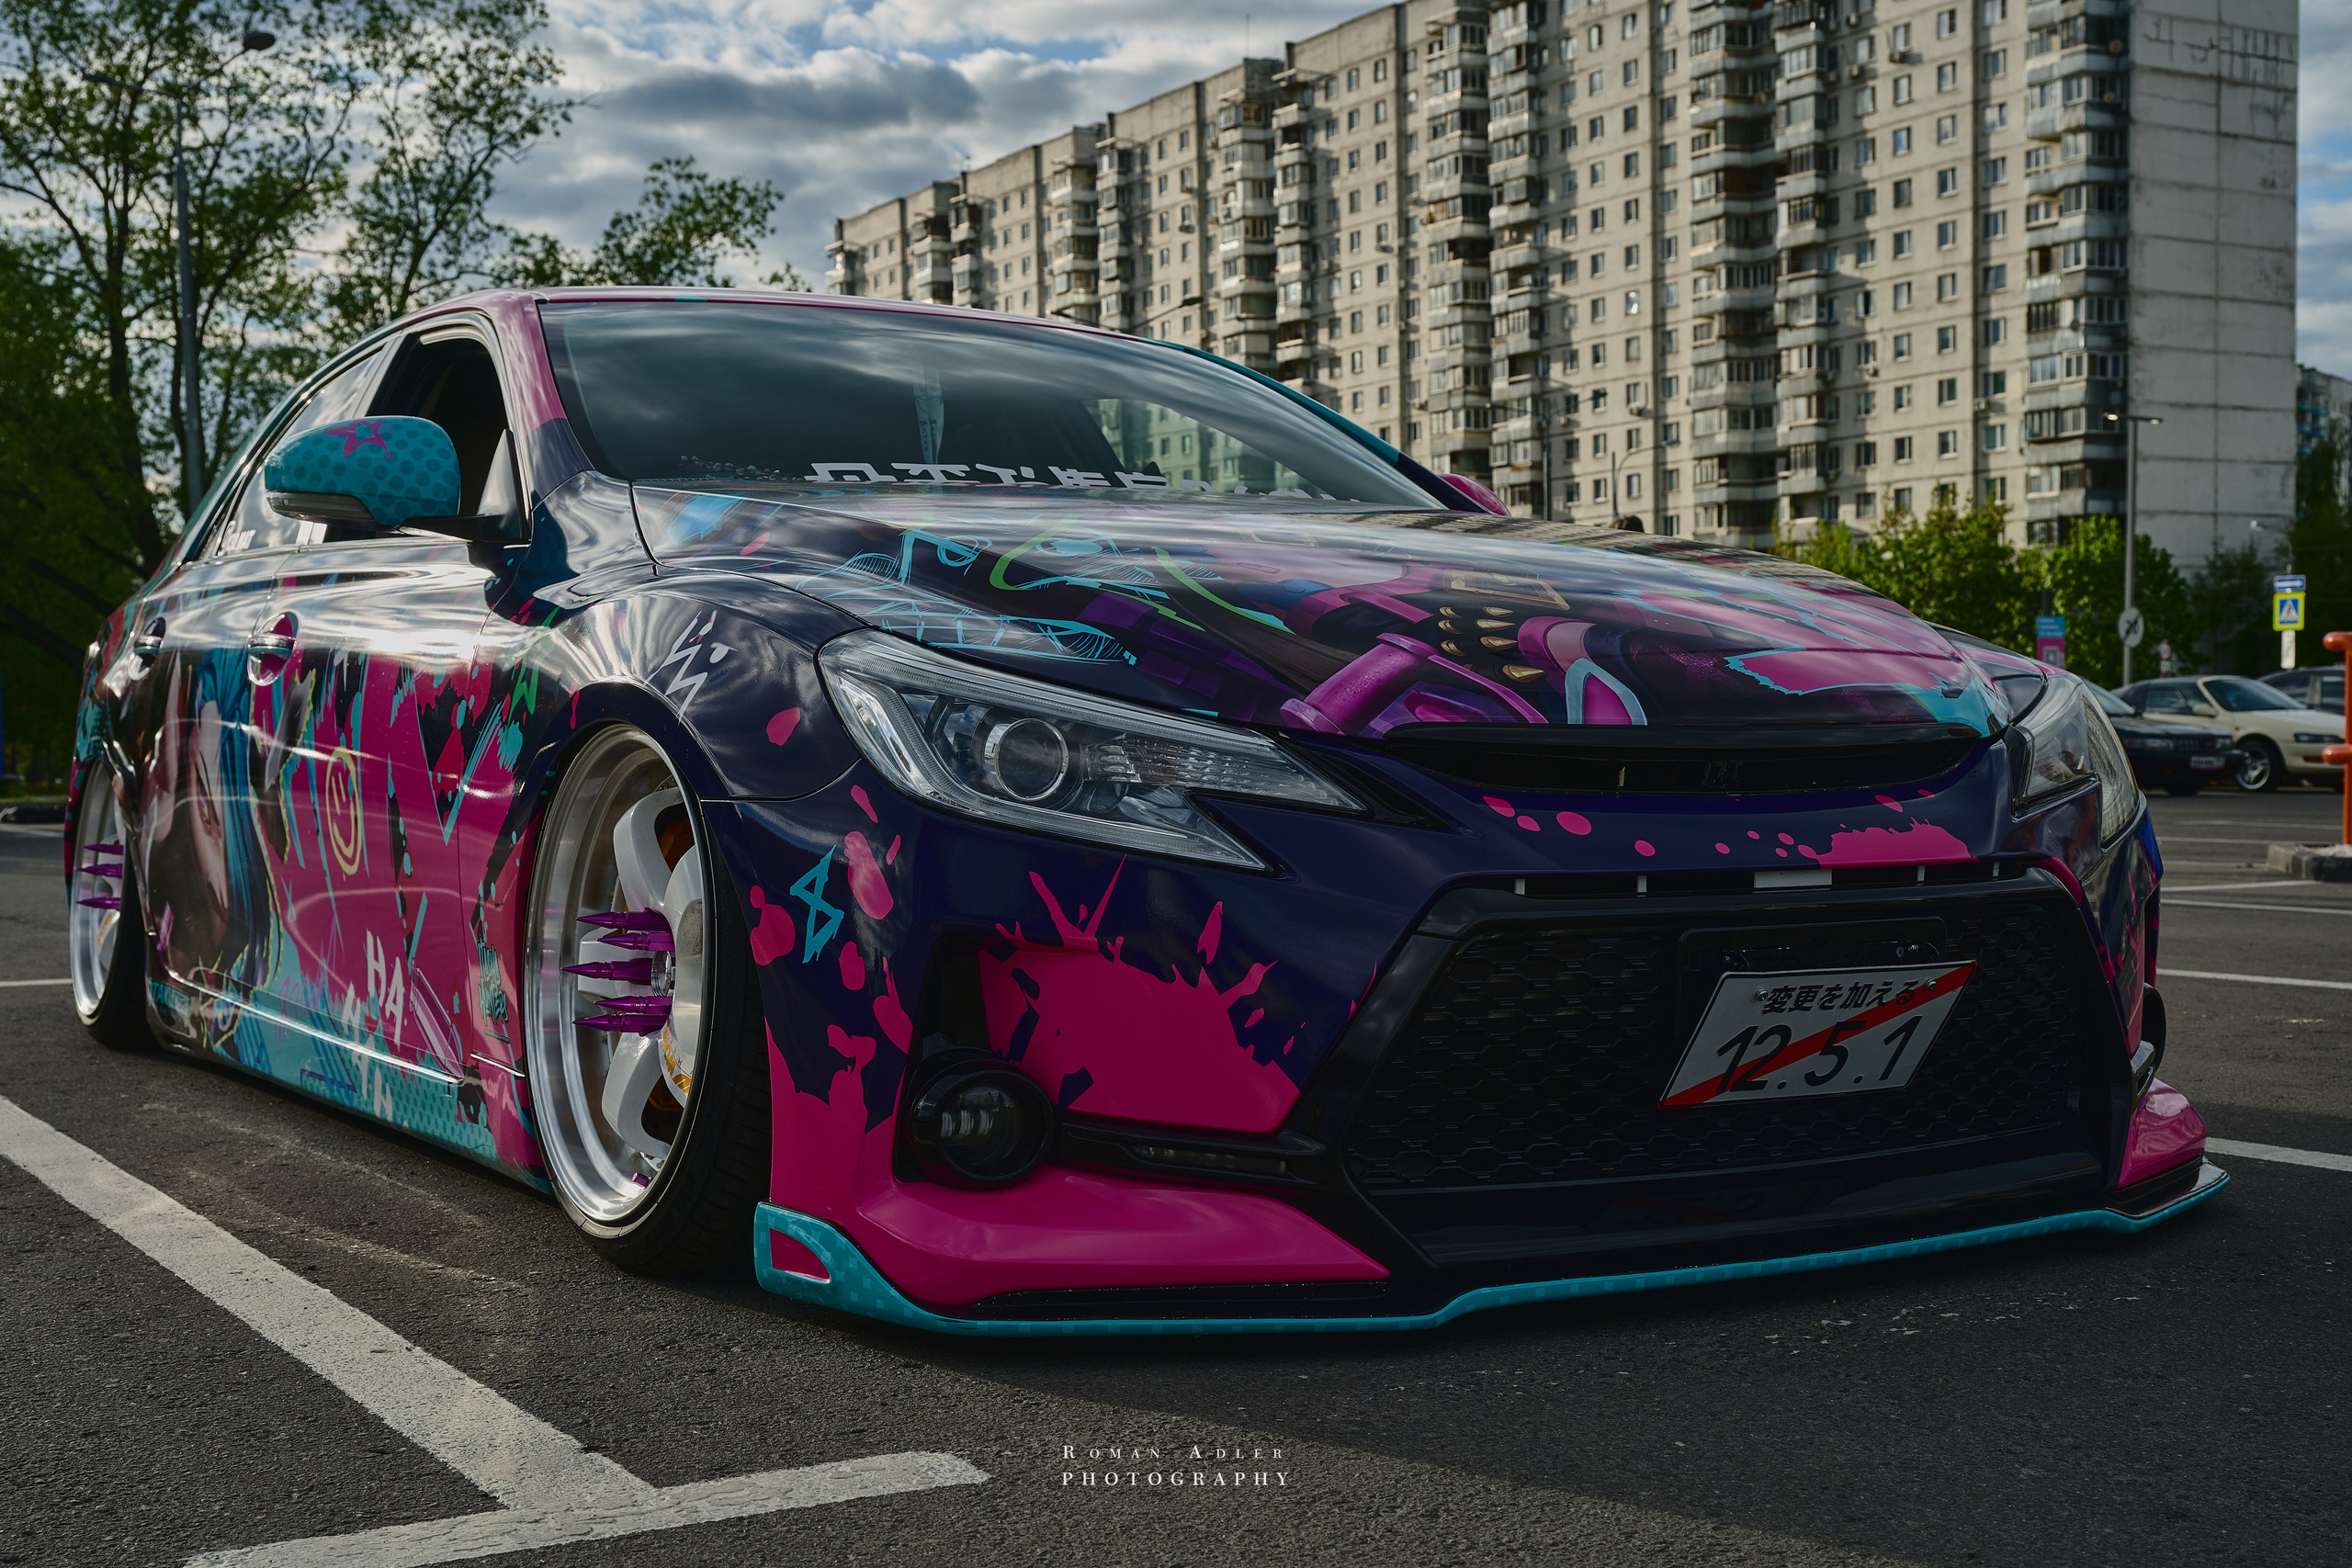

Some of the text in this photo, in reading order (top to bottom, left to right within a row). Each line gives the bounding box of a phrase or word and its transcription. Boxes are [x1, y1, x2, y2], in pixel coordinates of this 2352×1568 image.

[1761, 979, 1919, 1014] 変更を加える
[1714, 1015, 1923, 1094] 12.5.1
